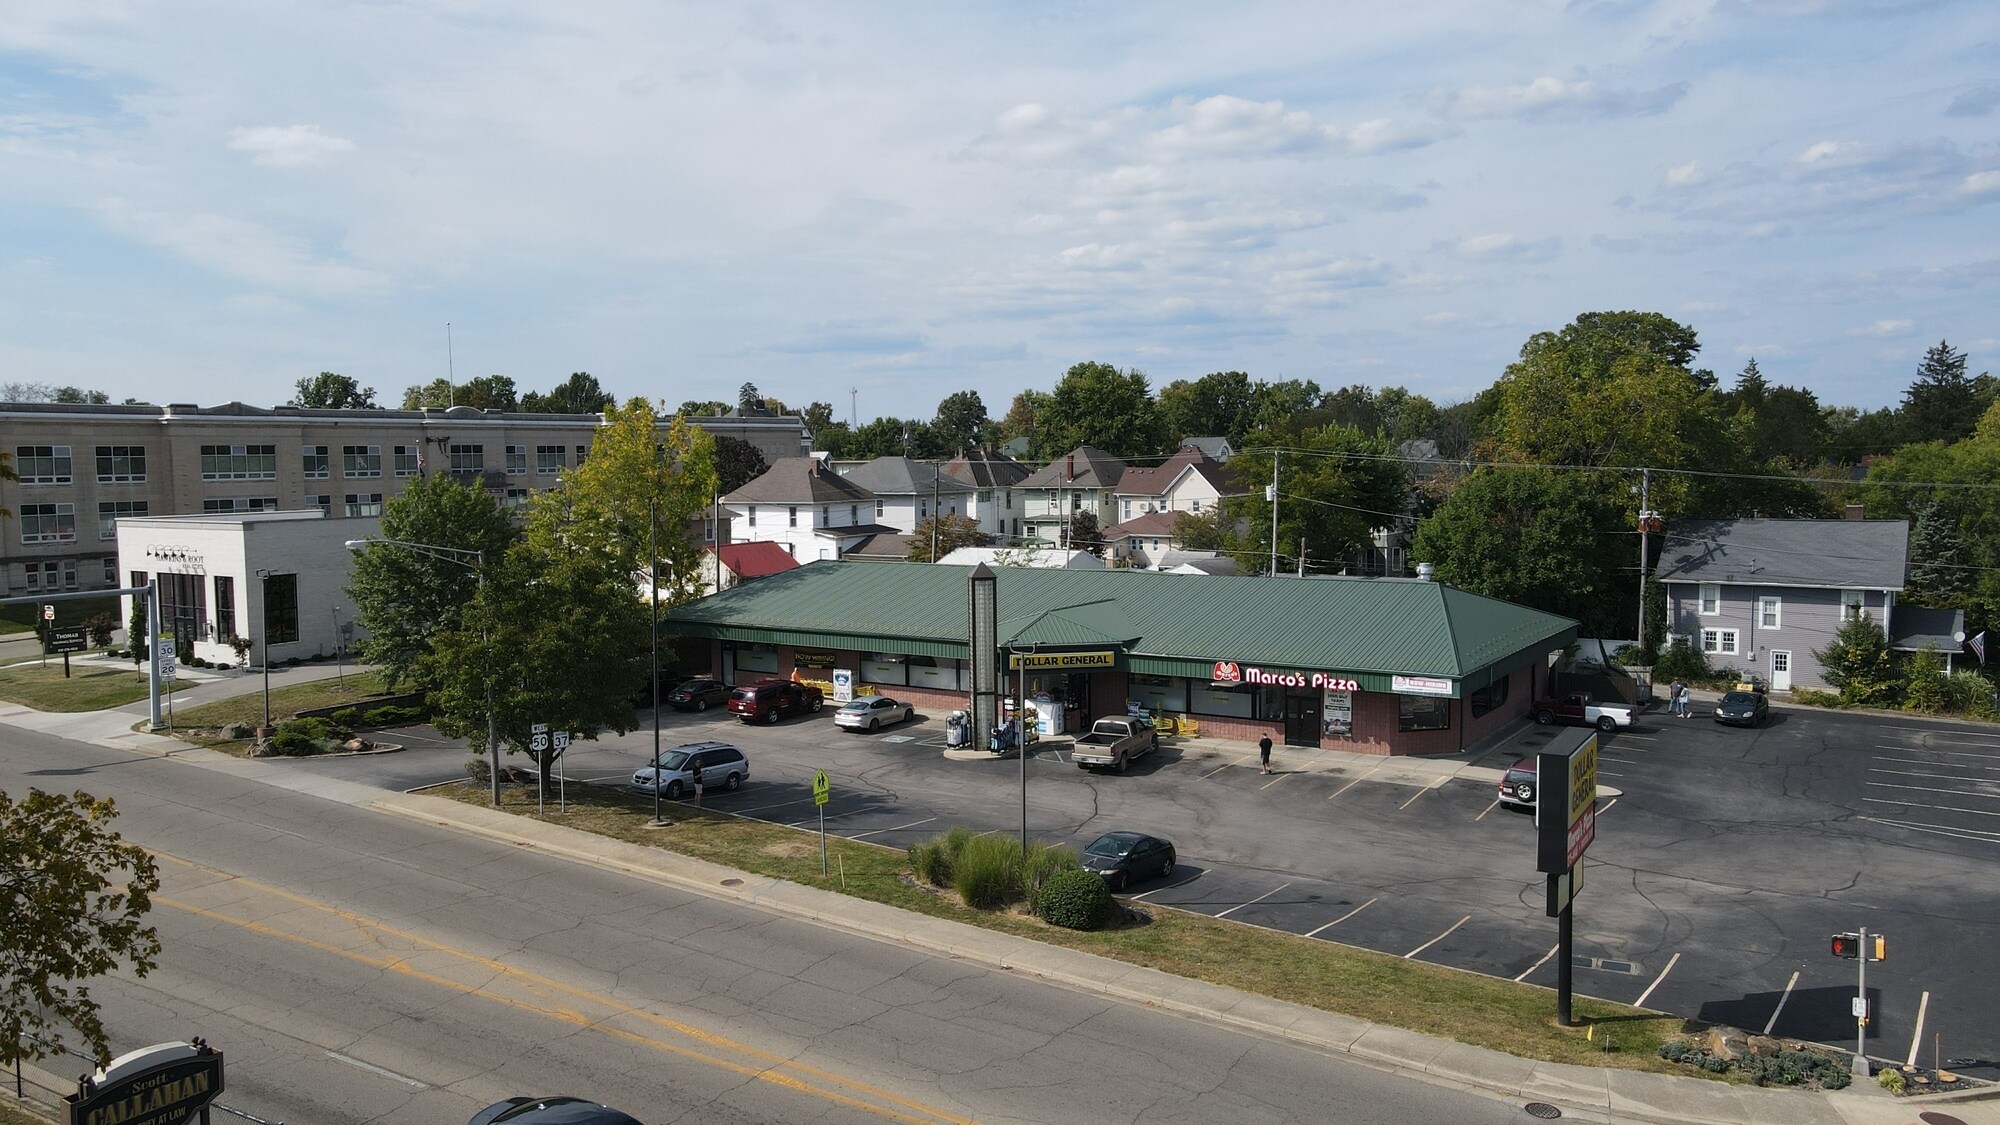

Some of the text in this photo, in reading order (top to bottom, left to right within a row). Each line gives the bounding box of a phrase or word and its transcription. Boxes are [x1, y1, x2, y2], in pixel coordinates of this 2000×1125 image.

[161, 647, 173, 655] 30
[1062, 655, 1110, 665] GENERAL
[162, 666, 175, 674] 20
[1245, 668, 1358, 691] Marco's Pizza
[534, 737, 546, 747] 50
[555, 736, 567, 746] 37
[131, 1072, 168, 1094] Scott
[87, 1069, 210, 1125] CALLAHAN
[158, 1112, 168, 1124] AT
[169, 1106, 186, 1123] LAW
